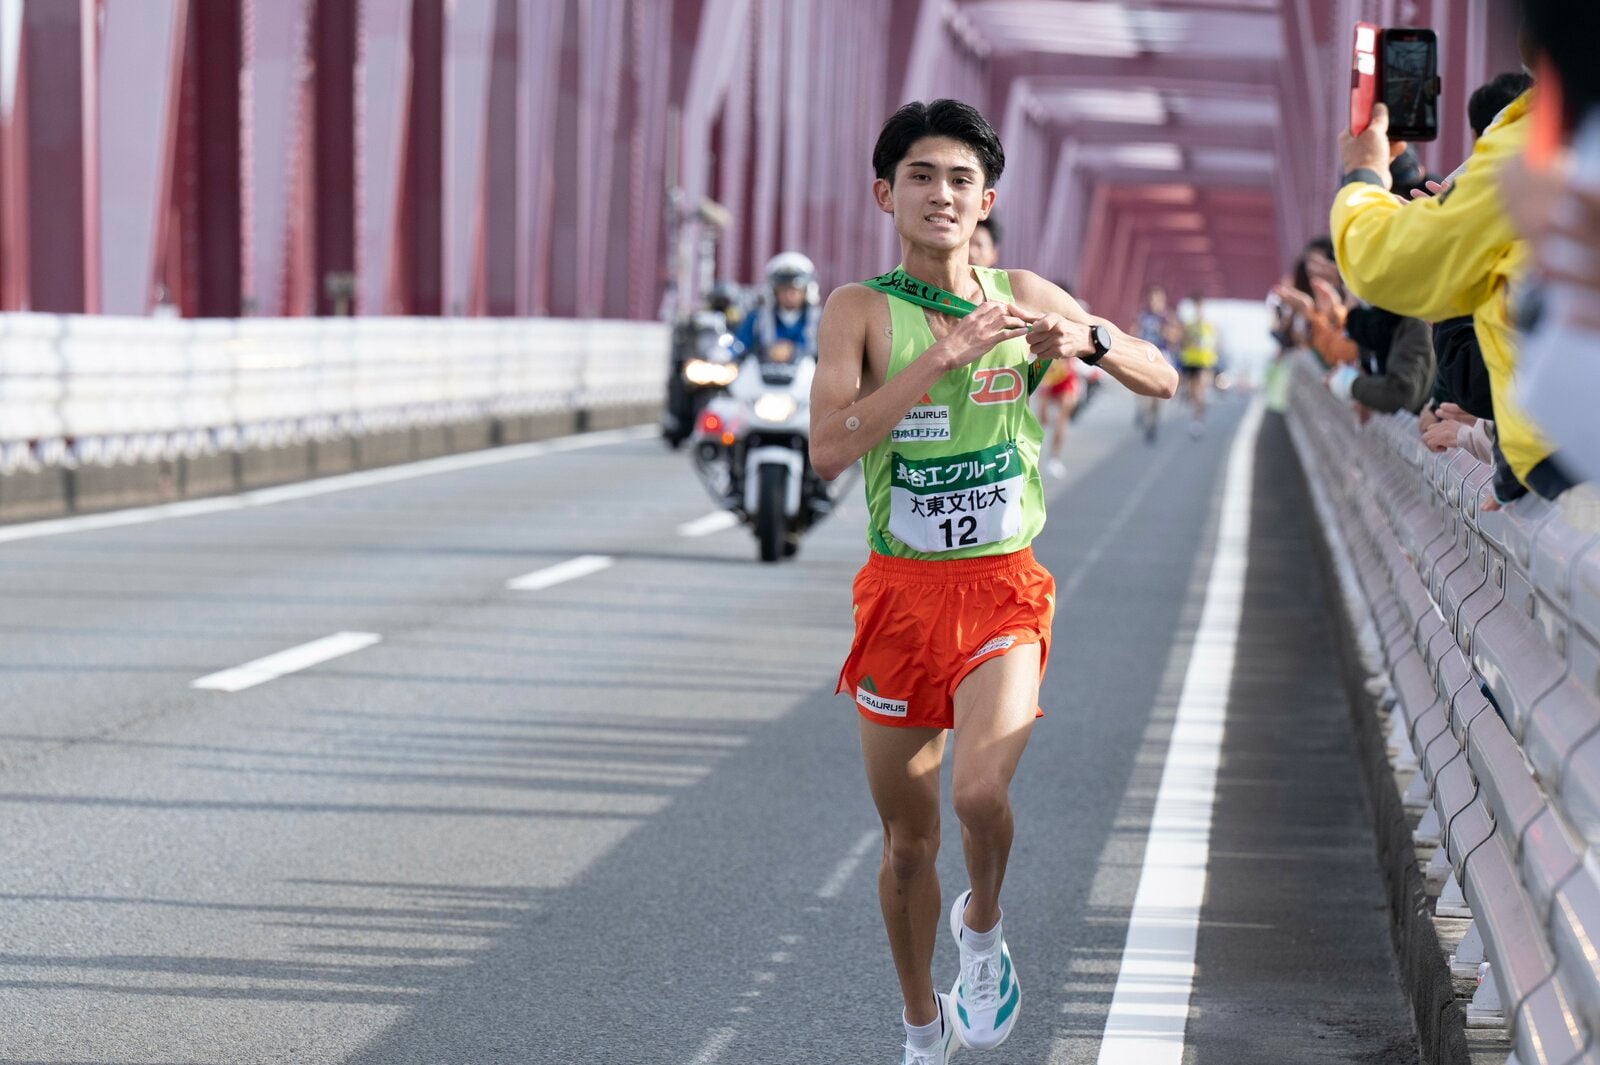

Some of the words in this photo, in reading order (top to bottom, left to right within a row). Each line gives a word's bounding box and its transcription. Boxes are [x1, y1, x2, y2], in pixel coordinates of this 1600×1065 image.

[904, 410, 948, 419] SAURUS
[911, 485, 1007, 518] 大東文化大
[939, 515, 978, 548] 12
